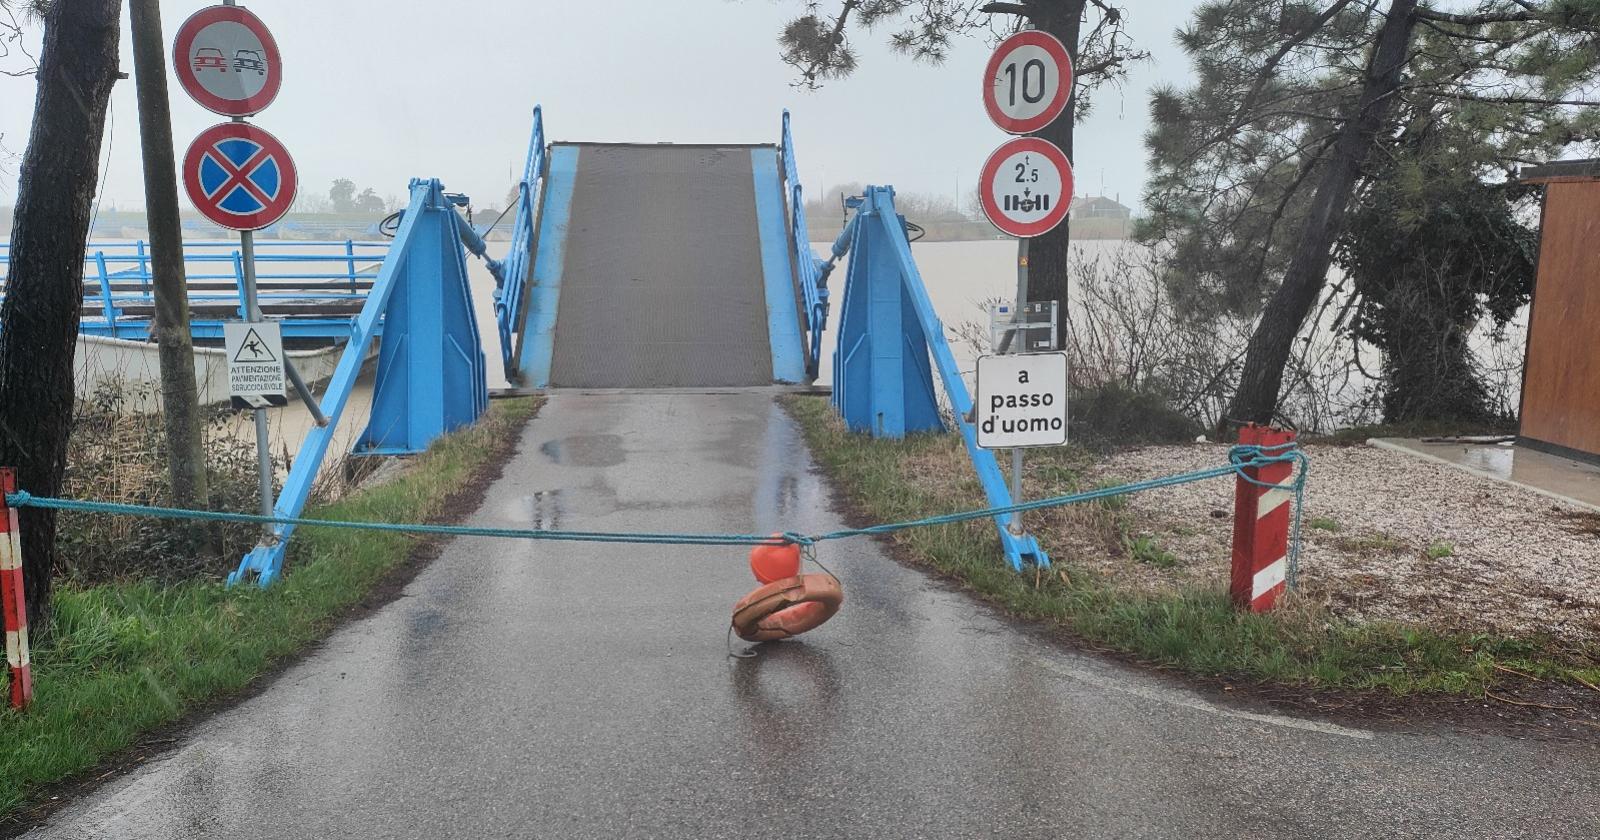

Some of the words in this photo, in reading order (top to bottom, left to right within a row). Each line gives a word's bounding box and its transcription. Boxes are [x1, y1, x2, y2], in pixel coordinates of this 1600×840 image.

[1005, 58, 1046, 107] 10
[1015, 162, 1039, 183] 2.5
[230, 365, 281, 374] ATTENZIONE
[1018, 369, 1030, 384] a
[991, 392, 1054, 413] passo
[981, 415, 1063, 434] d'uomo
